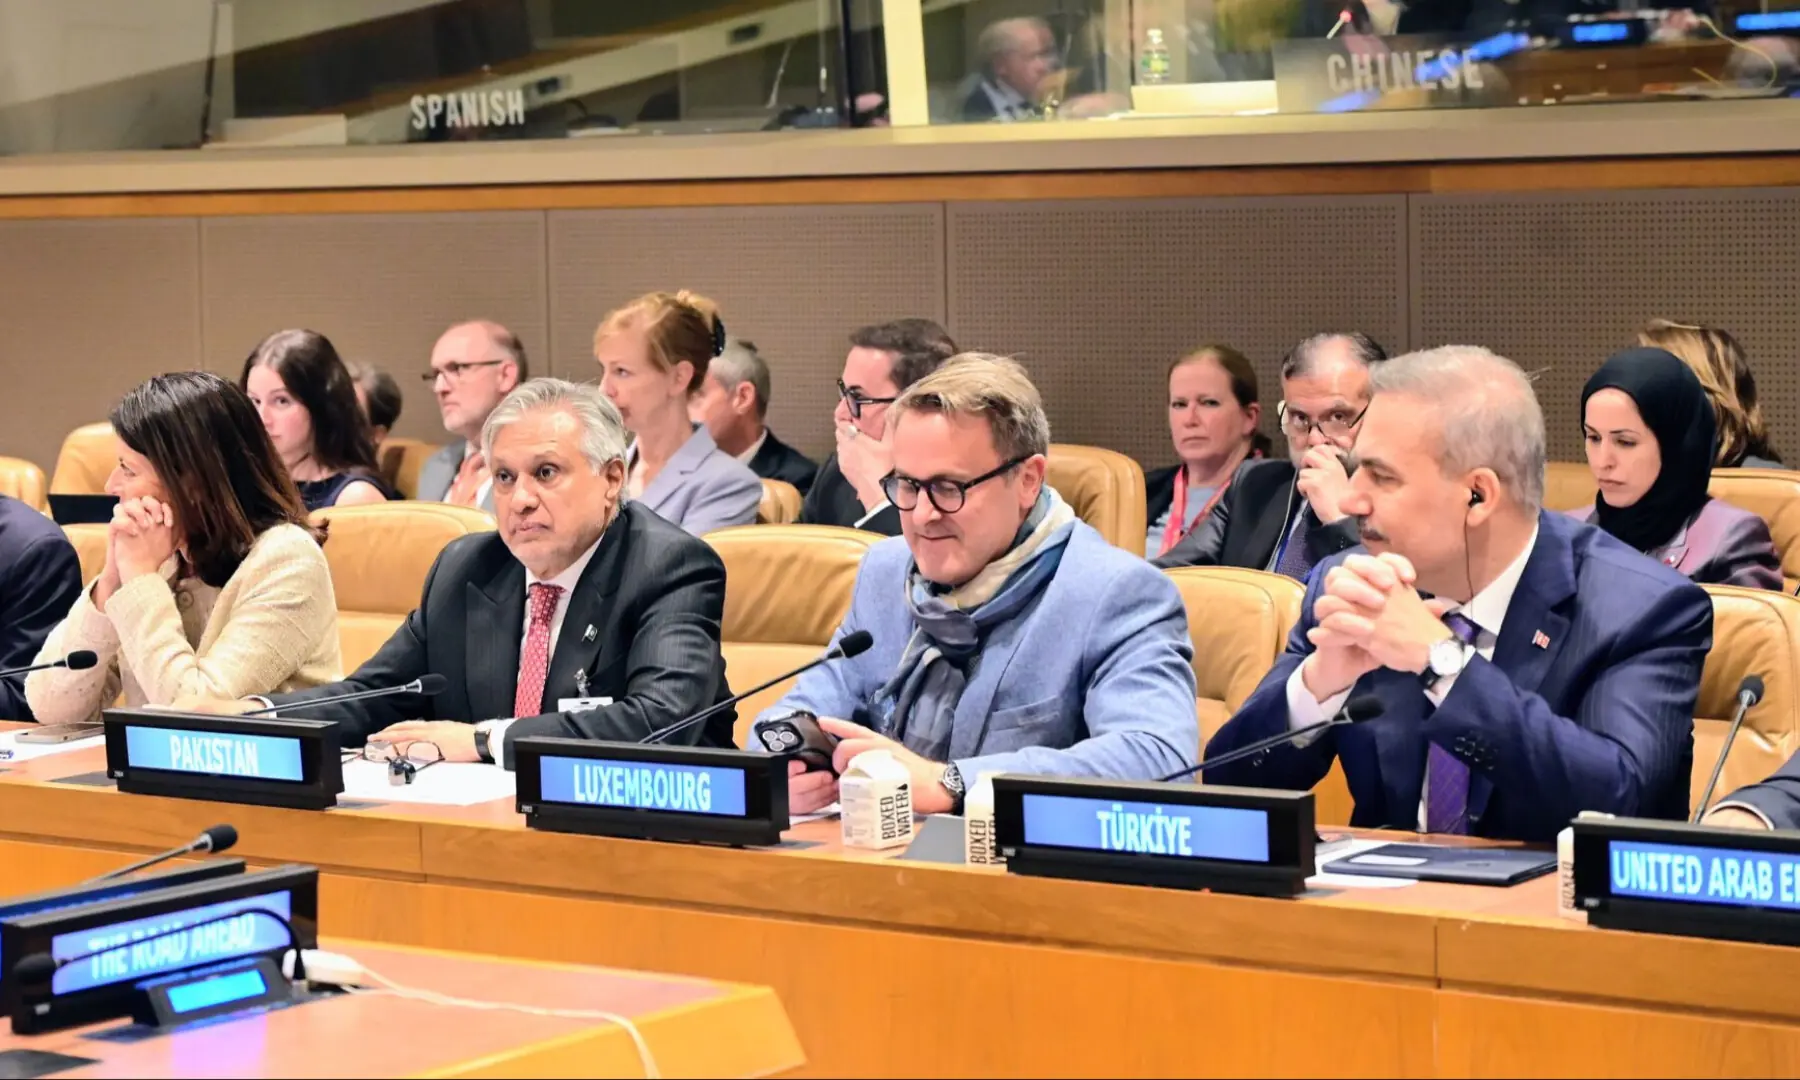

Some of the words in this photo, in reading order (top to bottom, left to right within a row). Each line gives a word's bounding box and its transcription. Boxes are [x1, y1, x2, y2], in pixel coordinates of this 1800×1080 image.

[1327, 48, 1484, 92] CHINESE
[410, 89, 525, 130] SPANISH
[169, 735, 259, 775] PAKISTAN
[573, 764, 711, 811] LUXEMBOURG
[880, 796, 896, 840] BOXED
[895, 792, 911, 837] WATER
[1097, 804, 1192, 856] TÜRKİYE
[969, 819, 986, 864] BOXED
[1611, 850, 1703, 895] UNITED
[1708, 857, 1773, 900] ARAB
[1780, 862, 1800, 903] E
[88, 933, 128, 979] THE
[132, 921, 188, 971] ROAD
[190, 912, 255, 960] AHEAD
